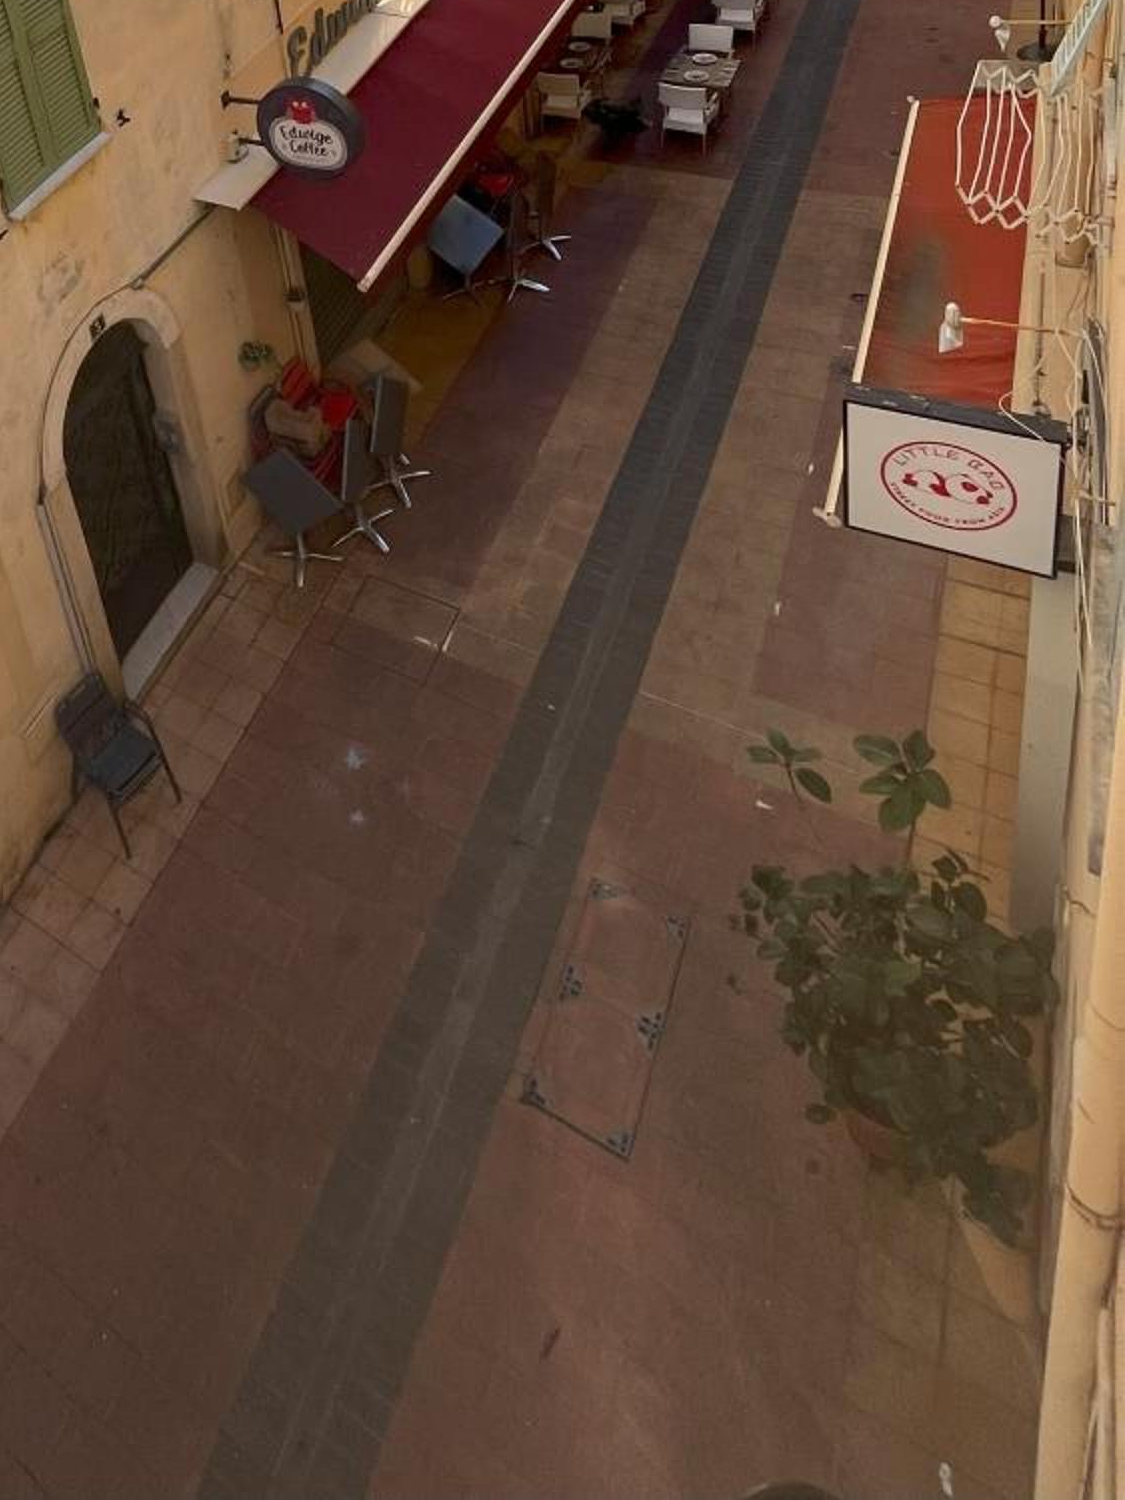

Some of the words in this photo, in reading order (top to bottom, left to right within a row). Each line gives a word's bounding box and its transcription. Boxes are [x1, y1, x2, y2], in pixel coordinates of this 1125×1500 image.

[279, 125, 334, 147] Edwige
[289, 139, 330, 157] Coffee
[893, 445, 959, 466] LITTLE
